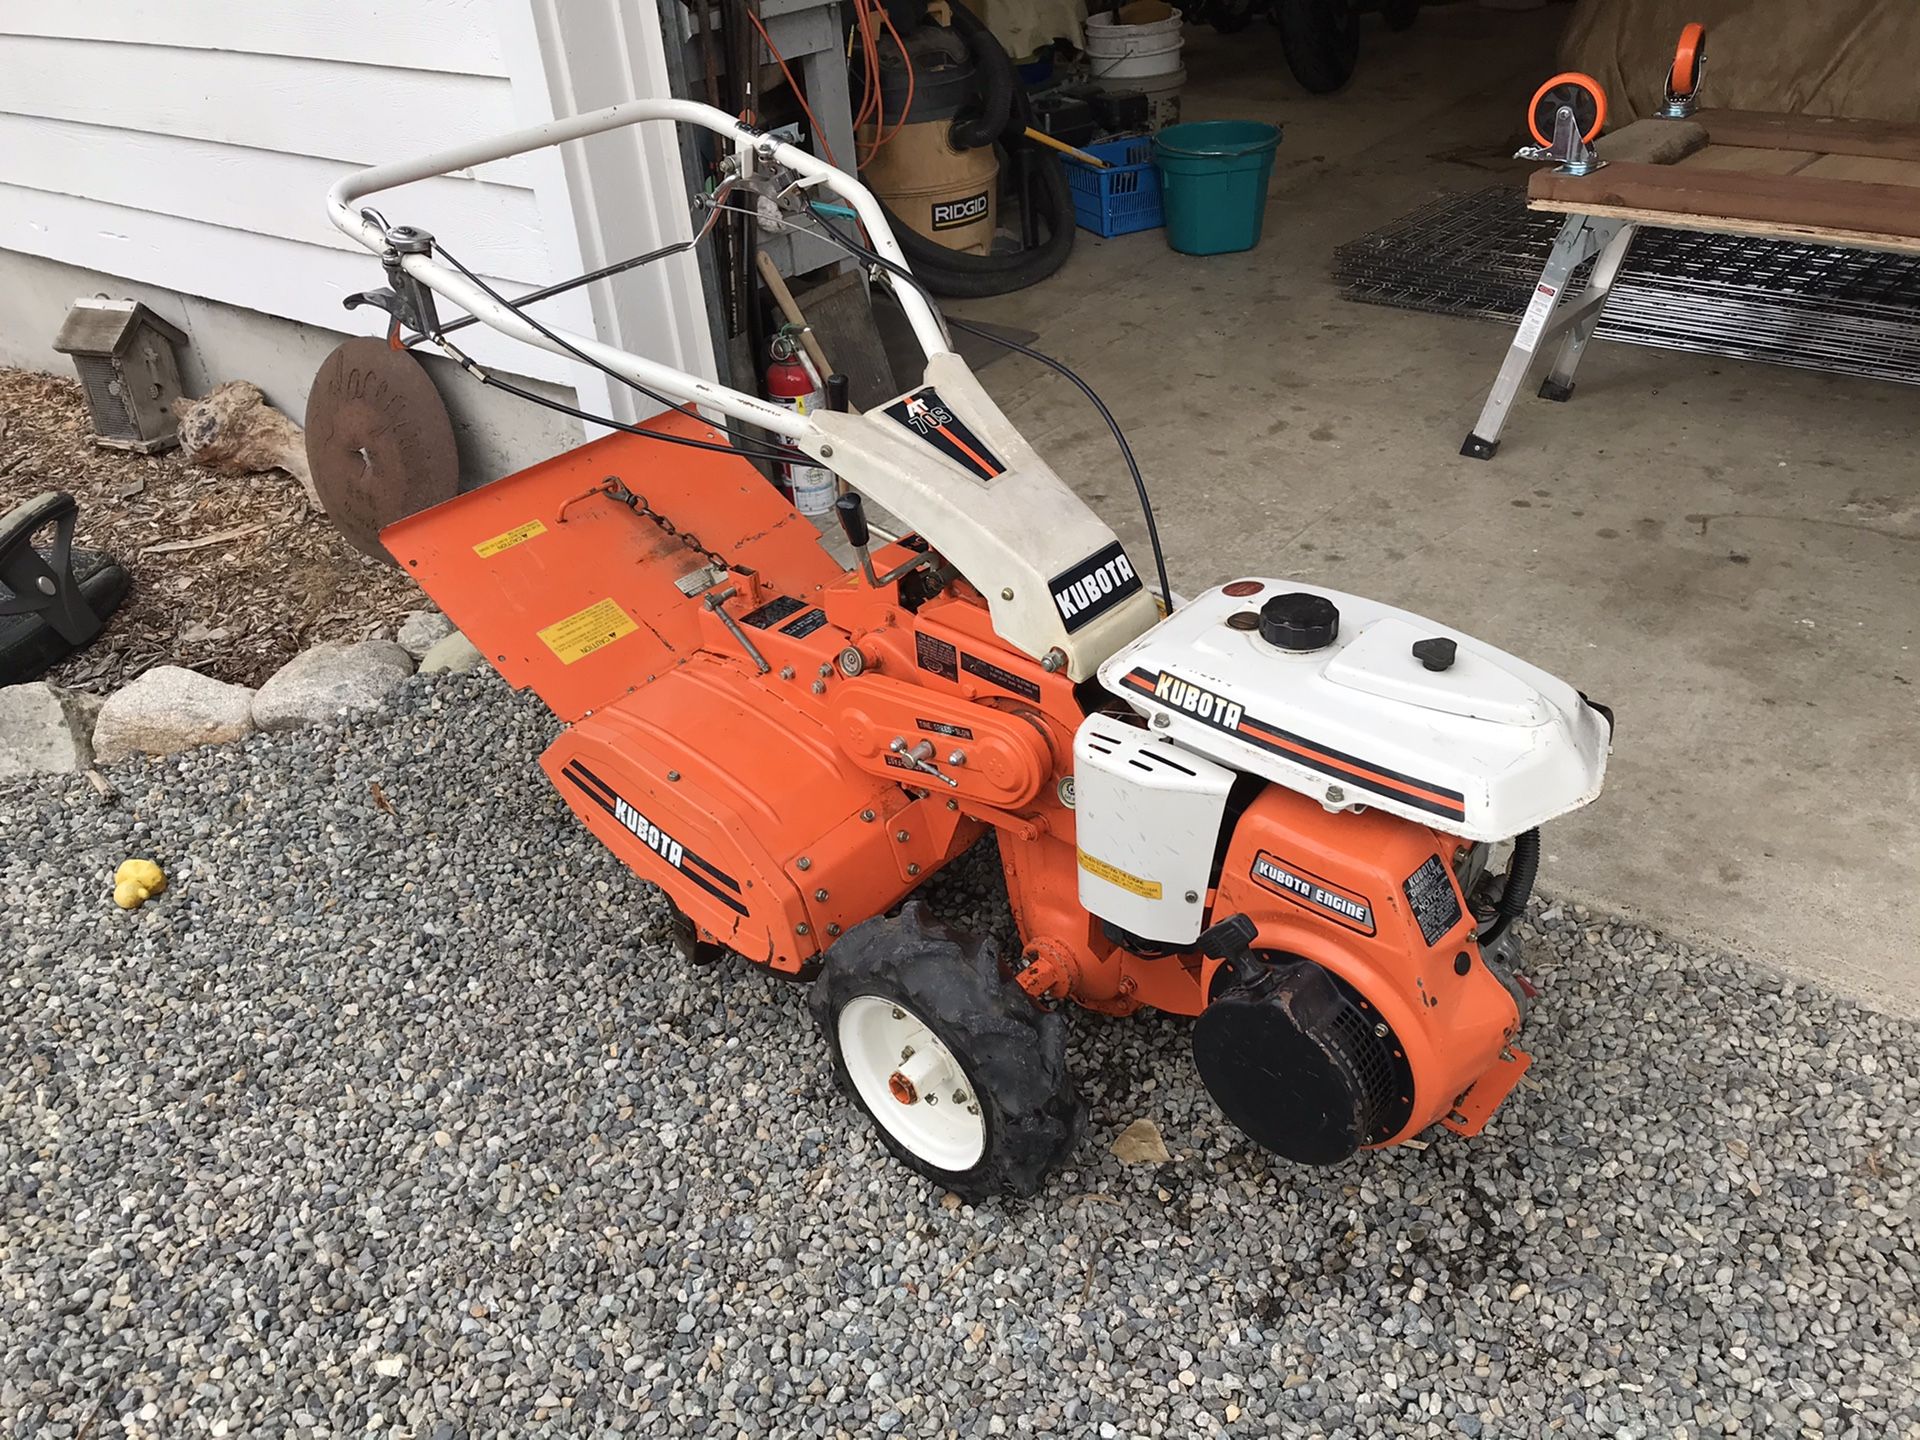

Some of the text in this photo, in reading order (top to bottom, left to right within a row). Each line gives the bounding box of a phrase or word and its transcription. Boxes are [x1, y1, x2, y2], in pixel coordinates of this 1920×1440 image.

[935, 196, 987, 222] RIDGID
[906, 398, 929, 418] AT
[908, 407, 952, 435] 70S
[1055, 553, 1135, 620] KUBOTA
[580, 635, 610, 654] CAUTION
[1154, 672, 1245, 731] KUBOTA
[614, 796, 683, 868] KUBOTA
[1408, 858, 1436, 888] KUBOTA
[1259, 862, 1365, 920] KUBOTA ENGINE
[1418, 885, 1445, 913] NOTICE
